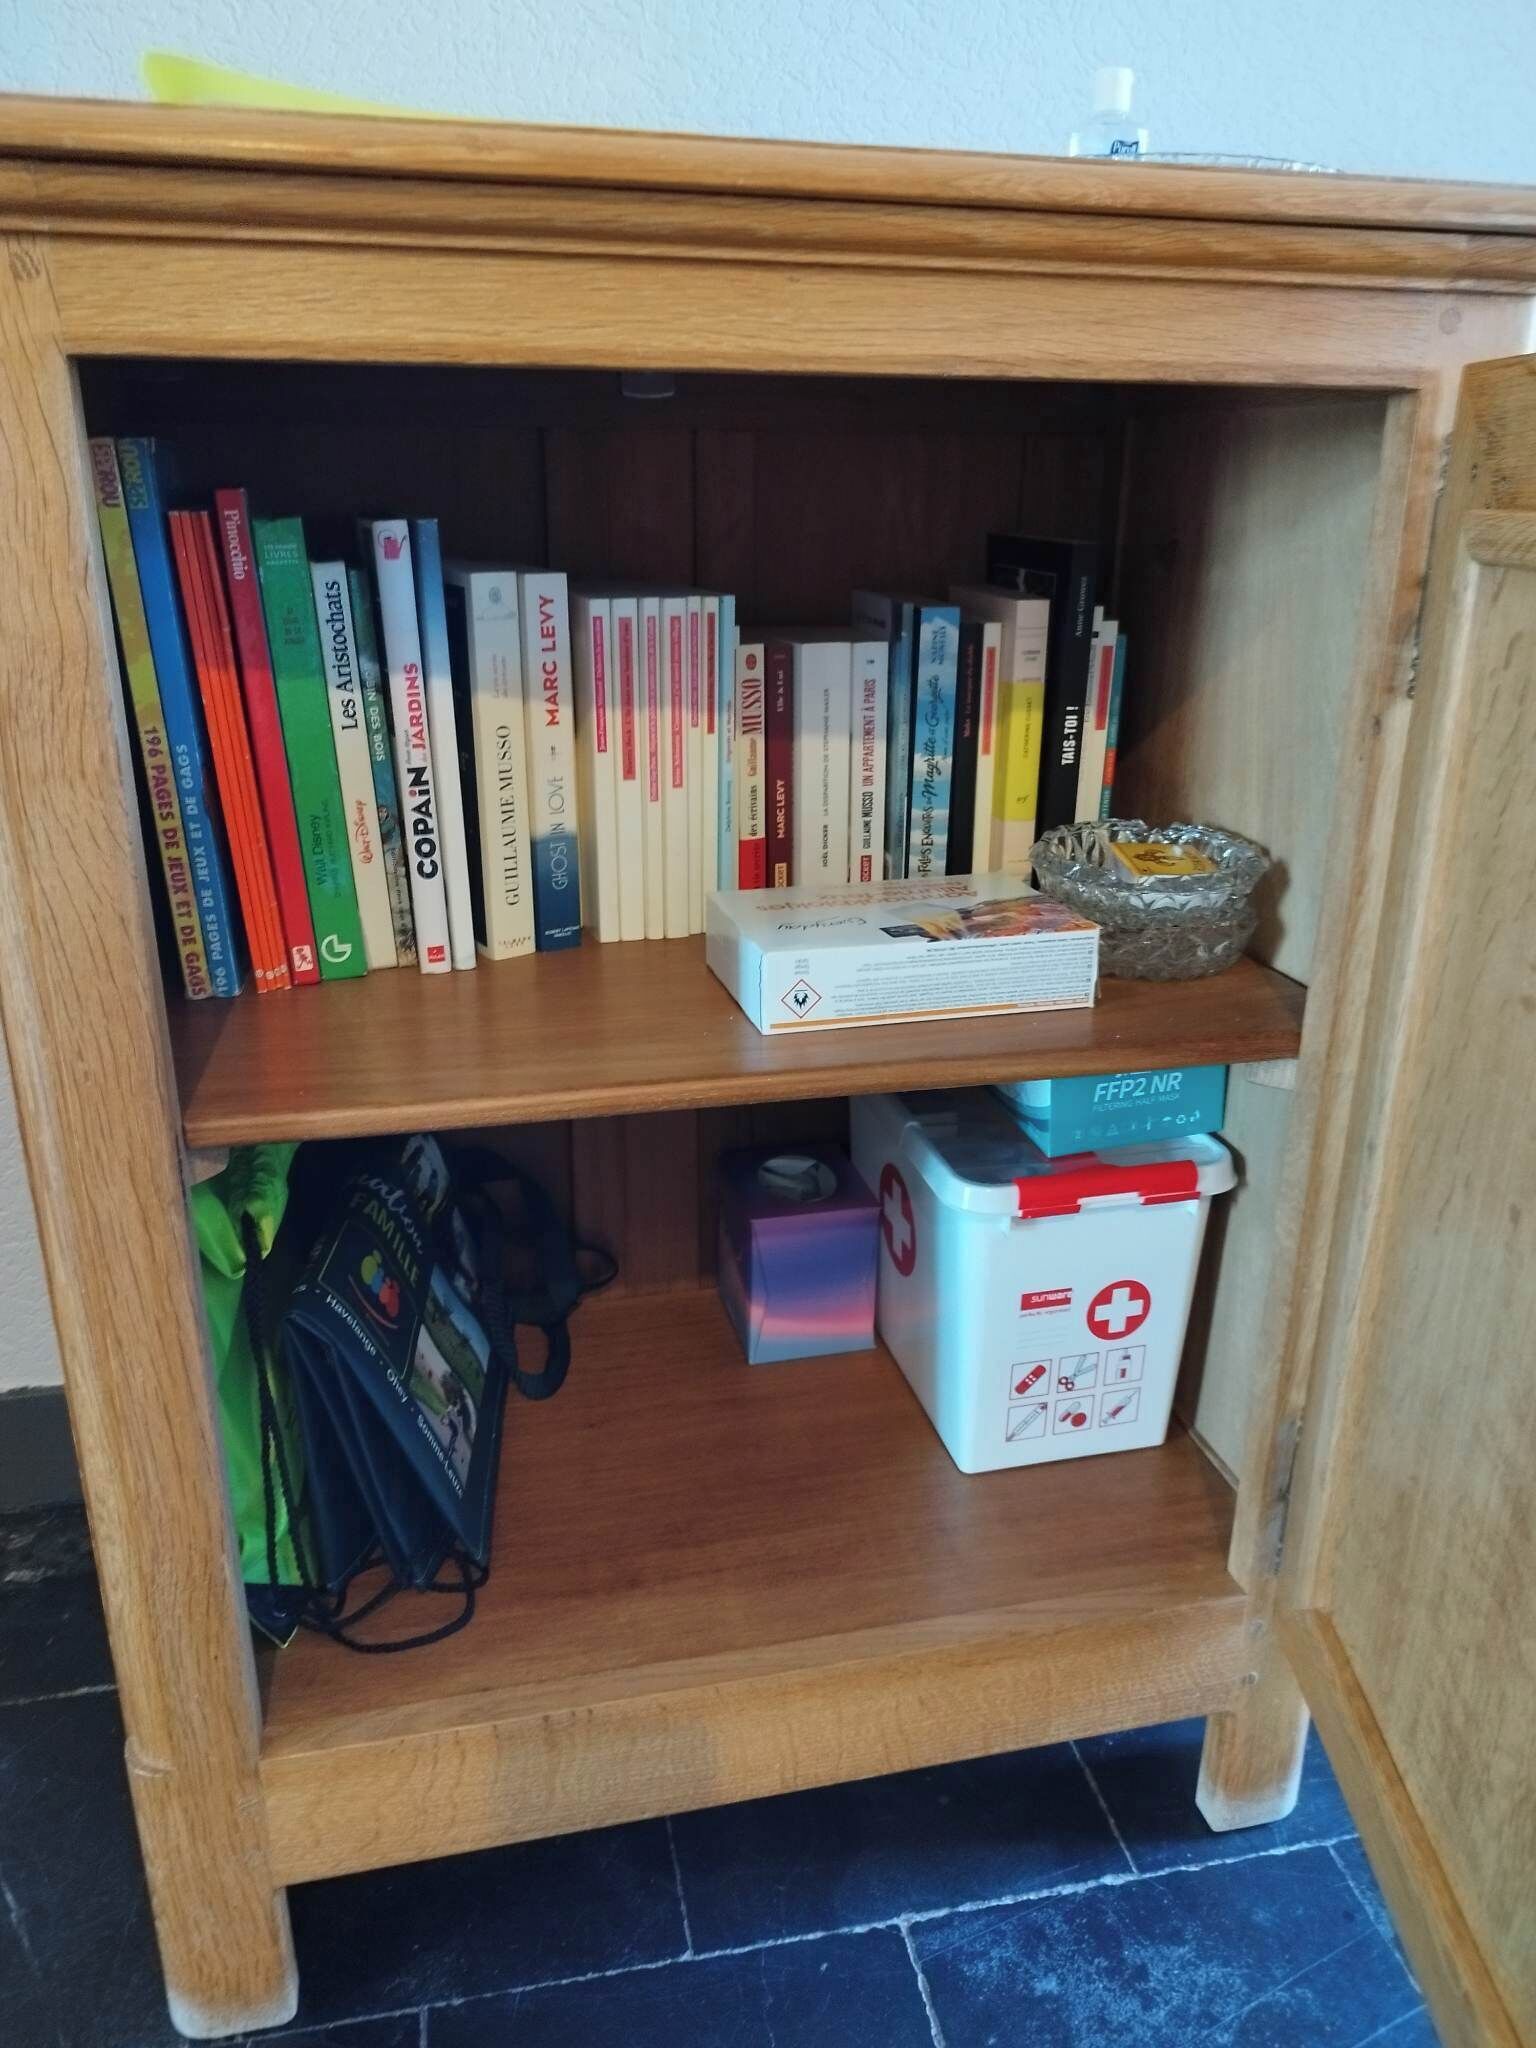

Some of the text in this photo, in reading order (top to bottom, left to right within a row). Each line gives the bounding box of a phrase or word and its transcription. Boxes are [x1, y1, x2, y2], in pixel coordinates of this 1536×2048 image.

[223, 510, 247, 581] Pinocchio
[325, 580, 358, 731] Les Aristochats
[539, 594, 560, 727] MARC LEVY
[369, 708, 381, 730] DES
[404, 662, 427, 750] JARDINS
[741, 679, 762, 736] MUSSO
[864, 678, 876, 704] PARIS
[373, 733, 386, 761] BOIS
[863, 715, 875, 772] APPARTEMENT
[922, 737, 941, 797] Magritte
[1061, 715, 1079, 765] TAIS-TOI
[749, 785, 758, 822] écrivains
[777, 779, 785, 839] MARC LEVY
[862, 774, 873, 787] UN
[496, 725, 520, 906] GUILLAUME MUSSO
[547, 776, 568, 890] GHOST IN LOVE
[862, 791, 873, 849] GUILLAUME MUSSO
[143, 726, 207, 997] 196 PAGES DE JEUX ET DE GAGS
[176, 744, 229, 993] 196 PAGES DE JEUX ET DE GAGS
[1093, 1077, 1150, 1102] FFP2
[1150, 1072, 1184, 1095] NR
[326, 1294, 377, 1356] Havelange
[386, 1368, 409, 1404] Ohey
